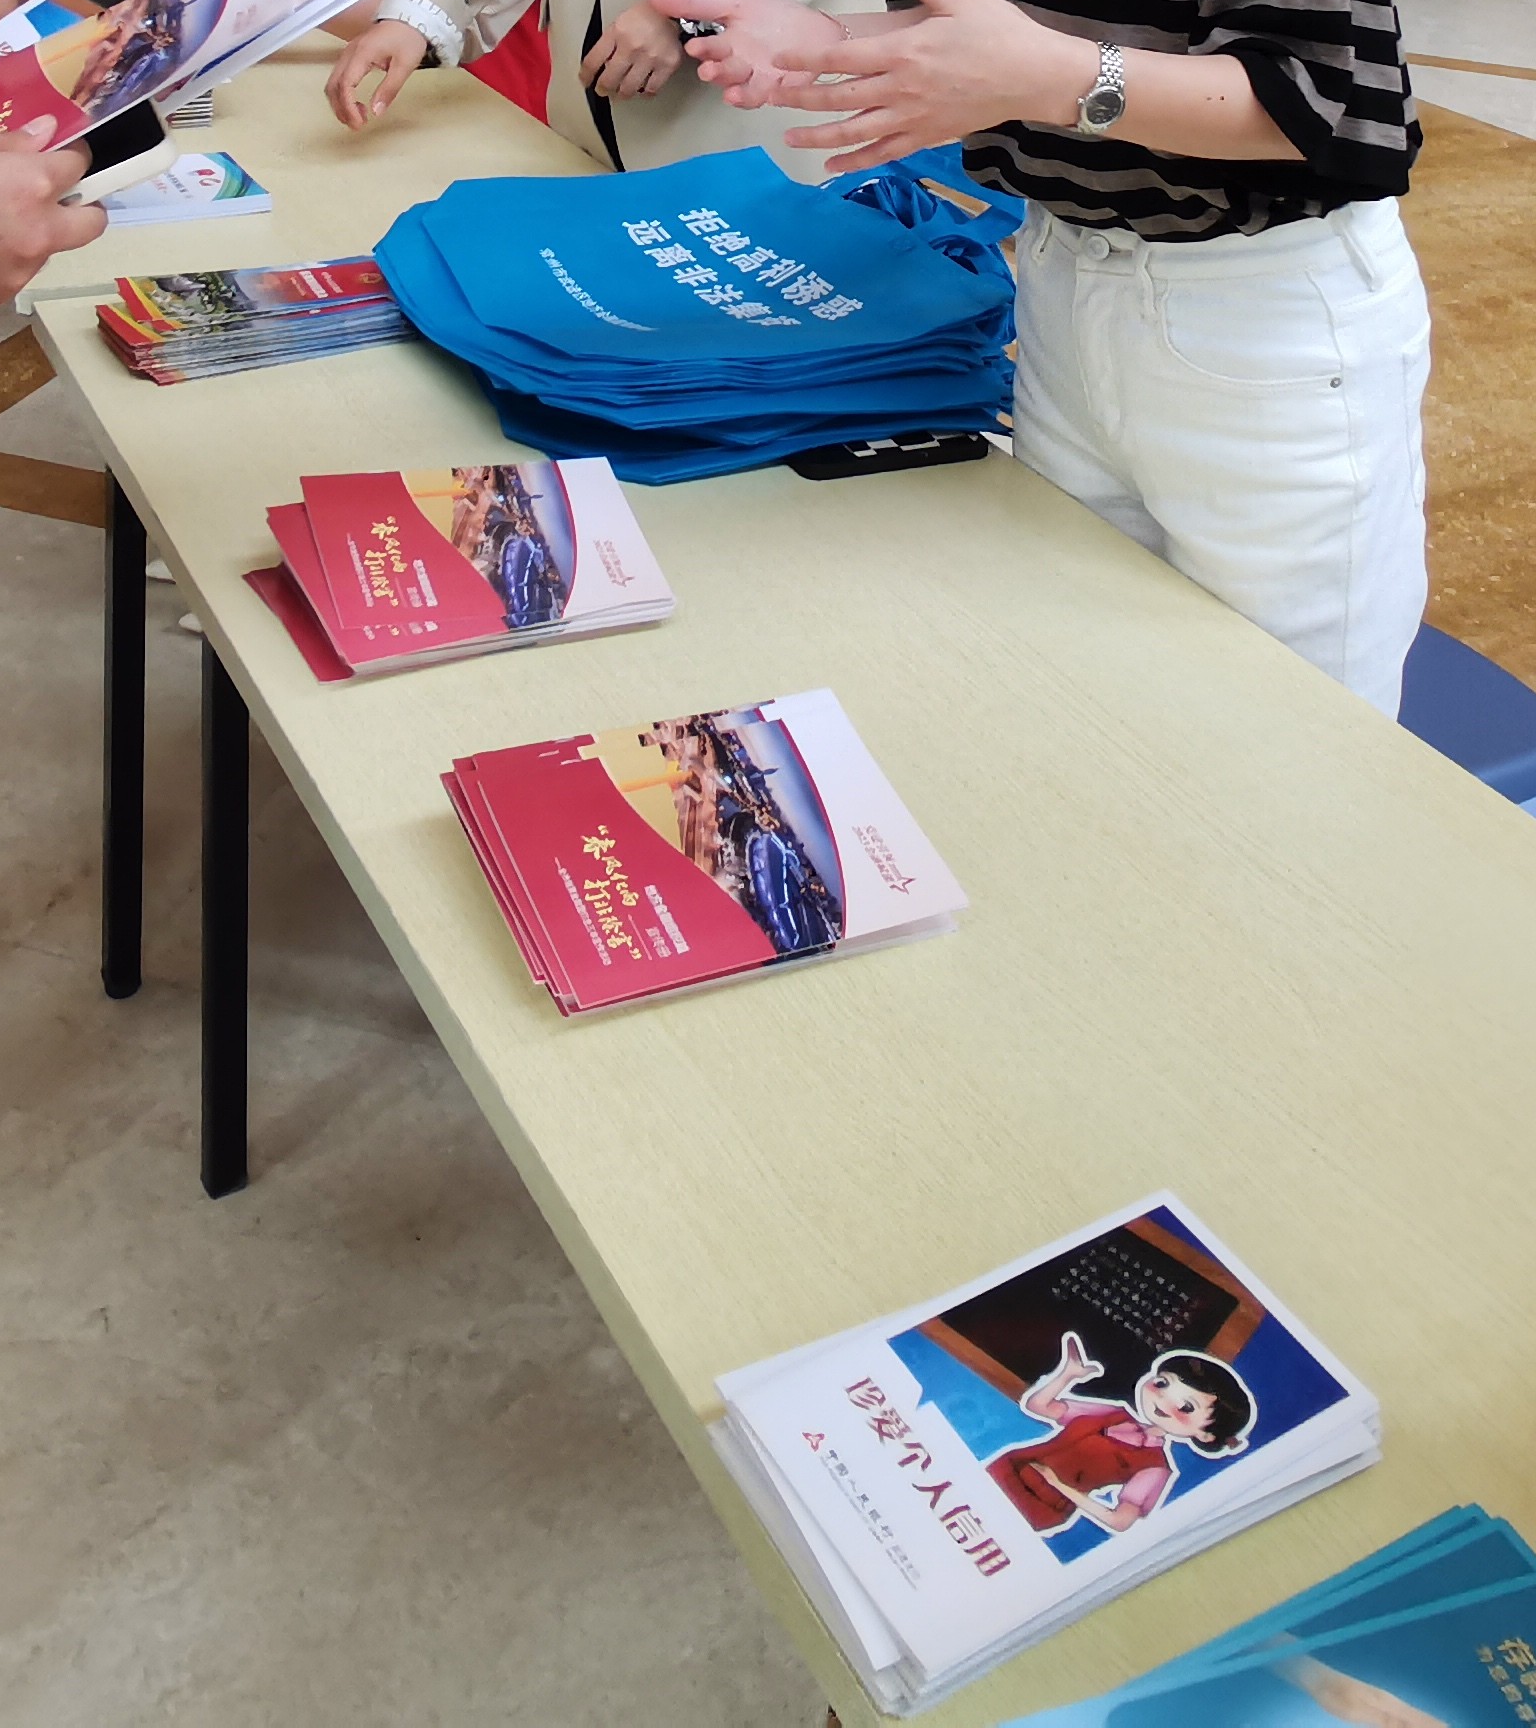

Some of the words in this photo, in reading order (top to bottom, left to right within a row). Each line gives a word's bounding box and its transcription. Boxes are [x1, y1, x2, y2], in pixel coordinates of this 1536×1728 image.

[621, 218, 803, 329] 远离非法集资
[677, 207, 865, 322] 拒绝高利诱惑
[843, 1374, 1013, 1578] 珍爱个人信用
